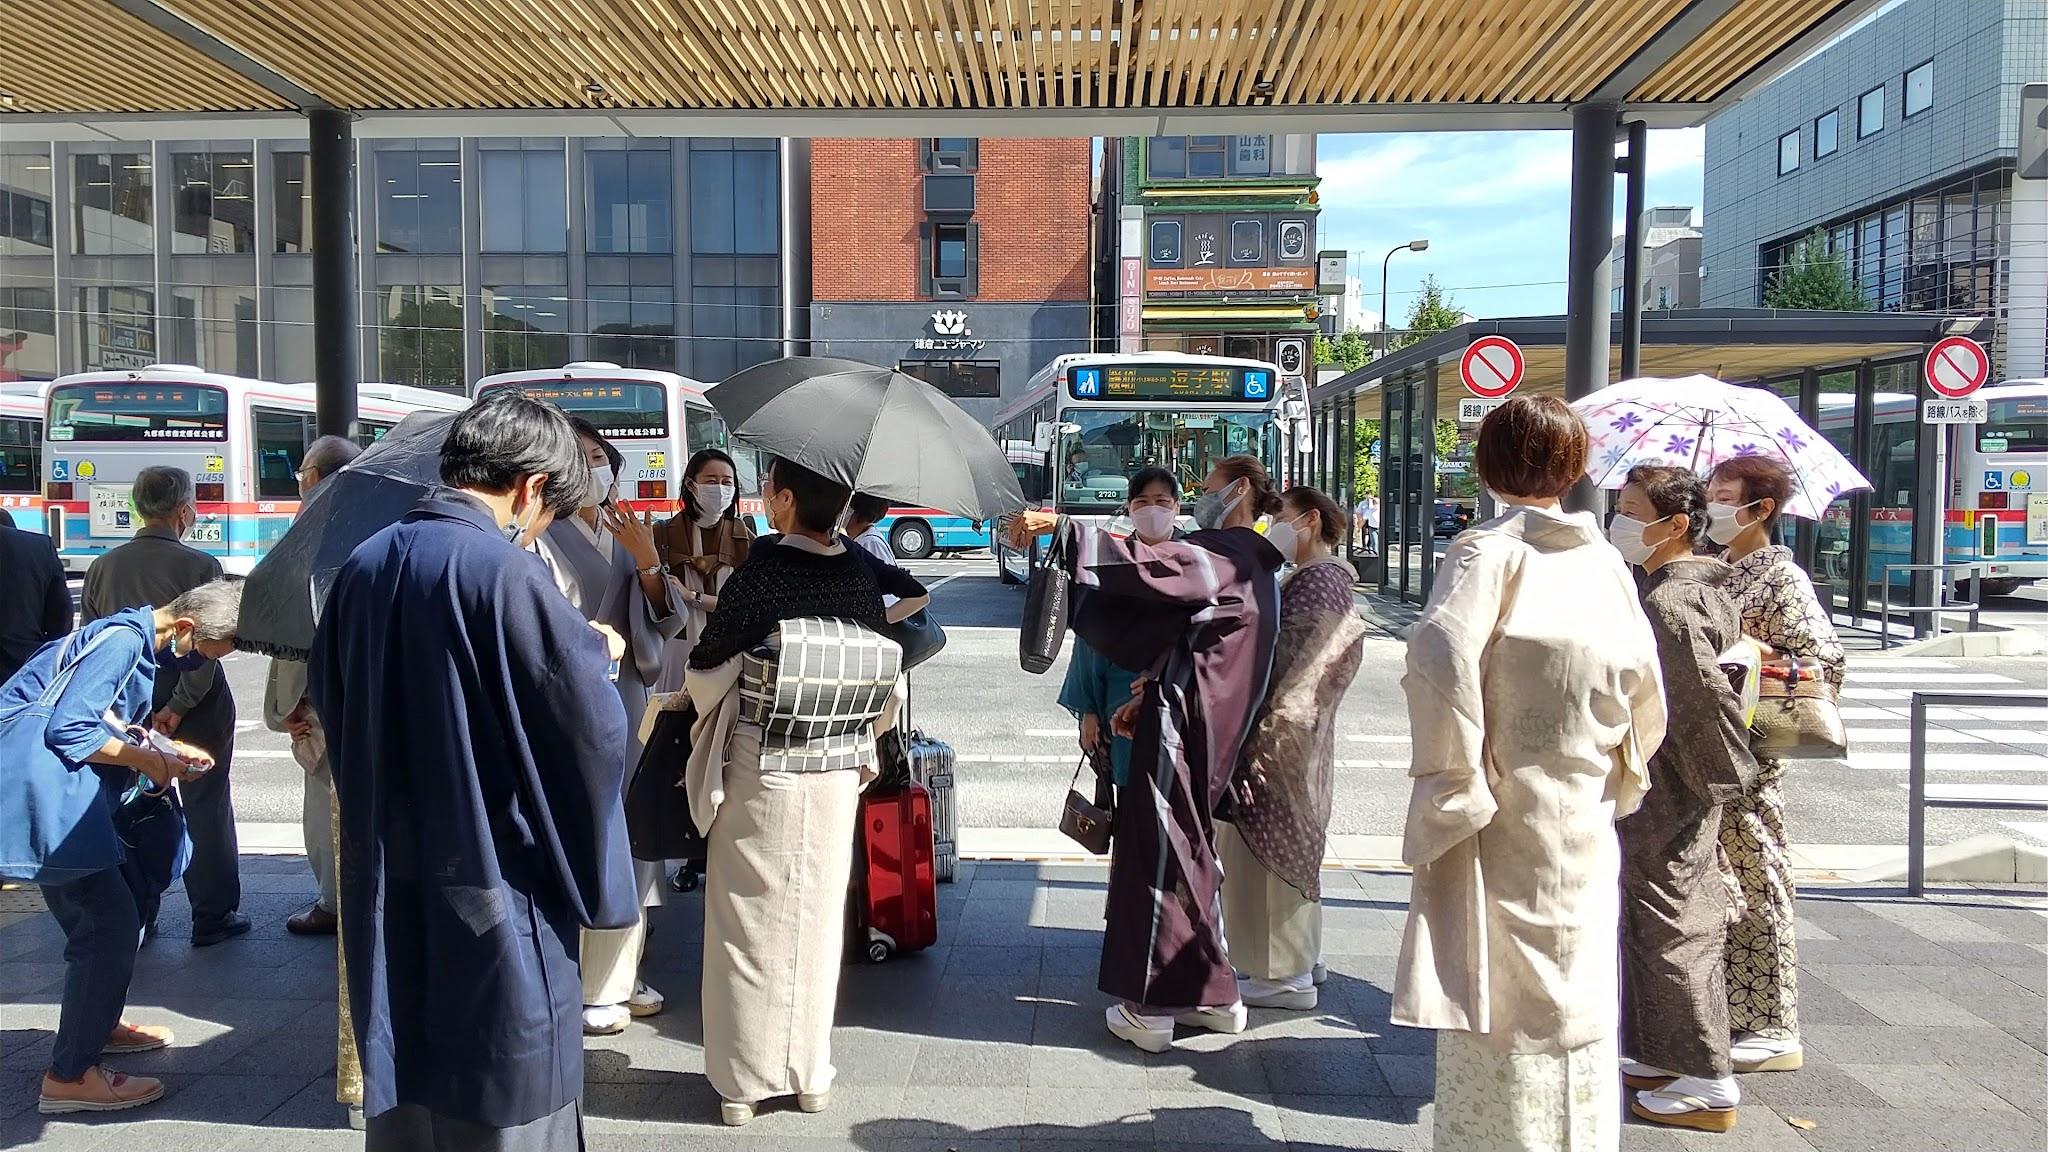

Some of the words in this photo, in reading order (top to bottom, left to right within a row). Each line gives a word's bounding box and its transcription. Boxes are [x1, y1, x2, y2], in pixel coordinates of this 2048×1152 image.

[1240, 135, 1265, 147] 山本
[1240, 149, 1265, 161] 歯科
[914, 338, 986, 350] 鎌倉ニュージャーマン
[1169, 369, 1230, 389] 逗子駅
[1463, 404, 1497, 418] 路線バ
[1927, 405, 1984, 418] 路線バスを除く
[195, 473, 224, 482] C1459
[638, 469, 666, 479] C1819
[1098, 490, 1117, 498] 2720
[1875, 510, 1898, 520] バス
